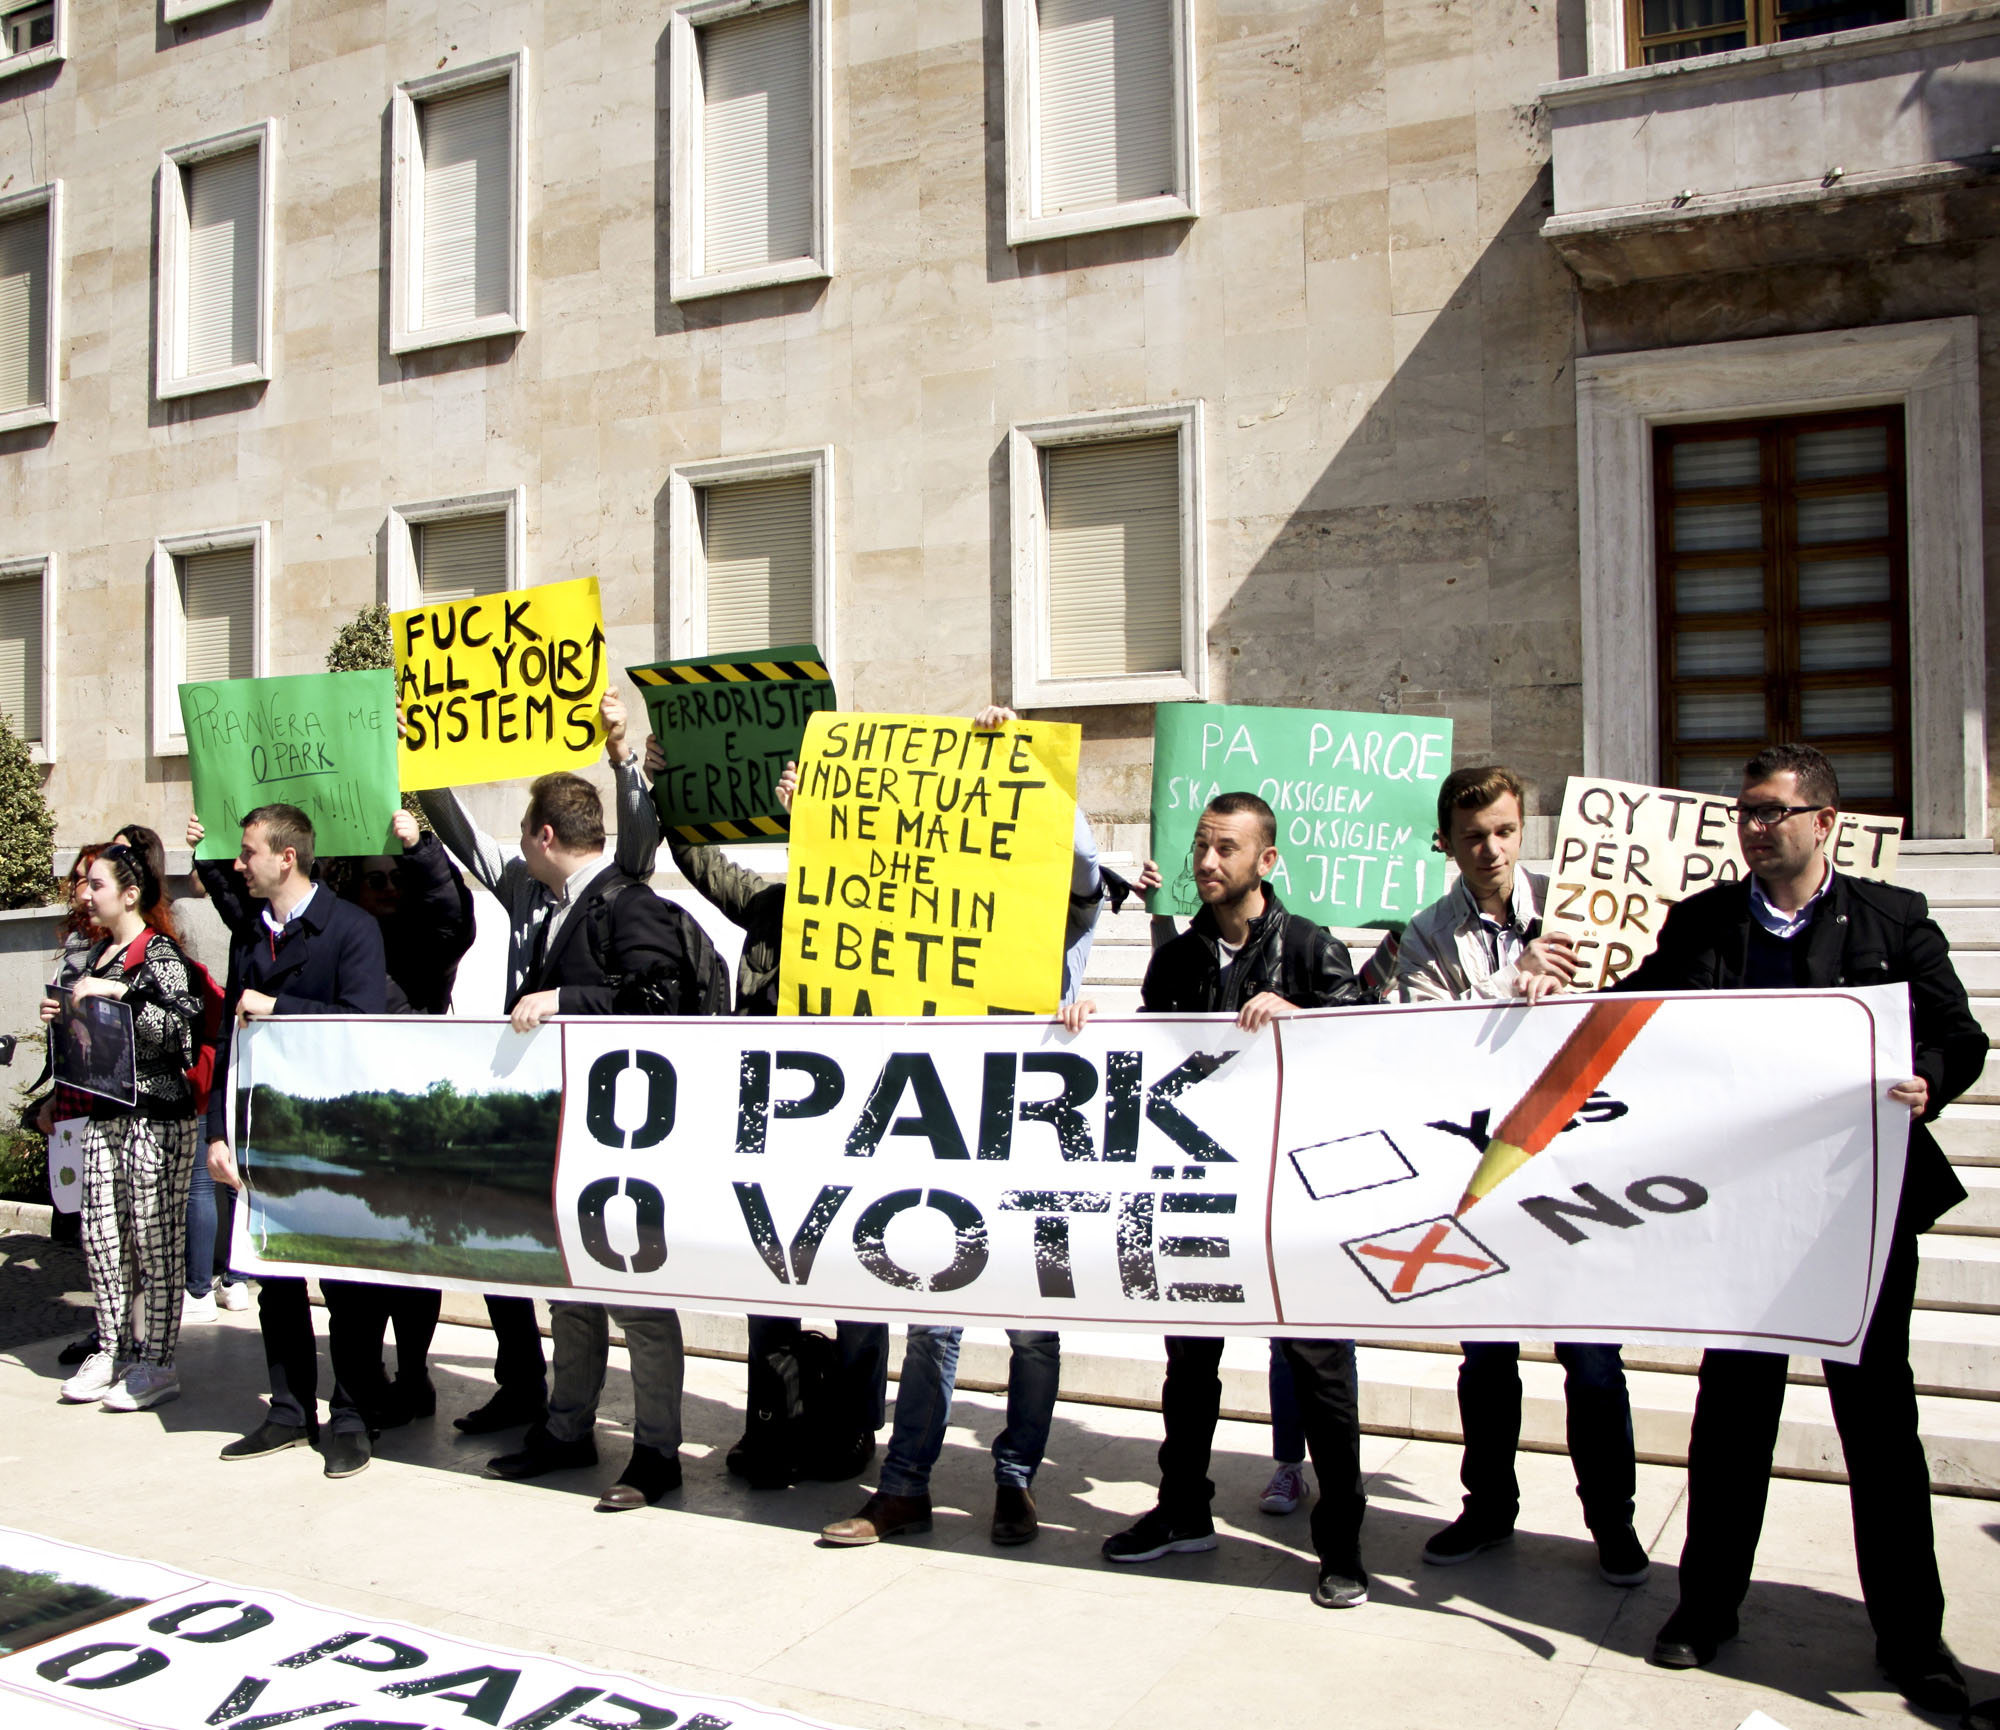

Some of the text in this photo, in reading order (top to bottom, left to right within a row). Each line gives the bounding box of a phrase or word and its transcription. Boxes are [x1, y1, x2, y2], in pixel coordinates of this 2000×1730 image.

[406, 599, 543, 657] FUCK
[400, 623, 605, 700] ALL YOUR
[188, 686, 383, 750] PRANVERA ME
[406, 689, 596, 751] SYSTEMS
[725, 731, 744, 763] E
[272, 742, 335, 776] PARK
[1202, 722, 1444, 783] PA PARQE
[896, 809, 1017, 861] MALE
[1558, 833, 1653, 887] PËR
[869, 848, 936, 885] DHE
[1305, 854, 1426, 911] JETË!
[798, 865, 995, 933] LIQENIN
[801, 918, 820, 961] E
[735, 1050, 1240, 1163] PARK
[1423, 1091, 1629, 1154] YS
[731, 1165, 1245, 1303] VOTË
[1517, 1175, 1709, 1246] NO
[271, 1631, 734, 1730] PAR
